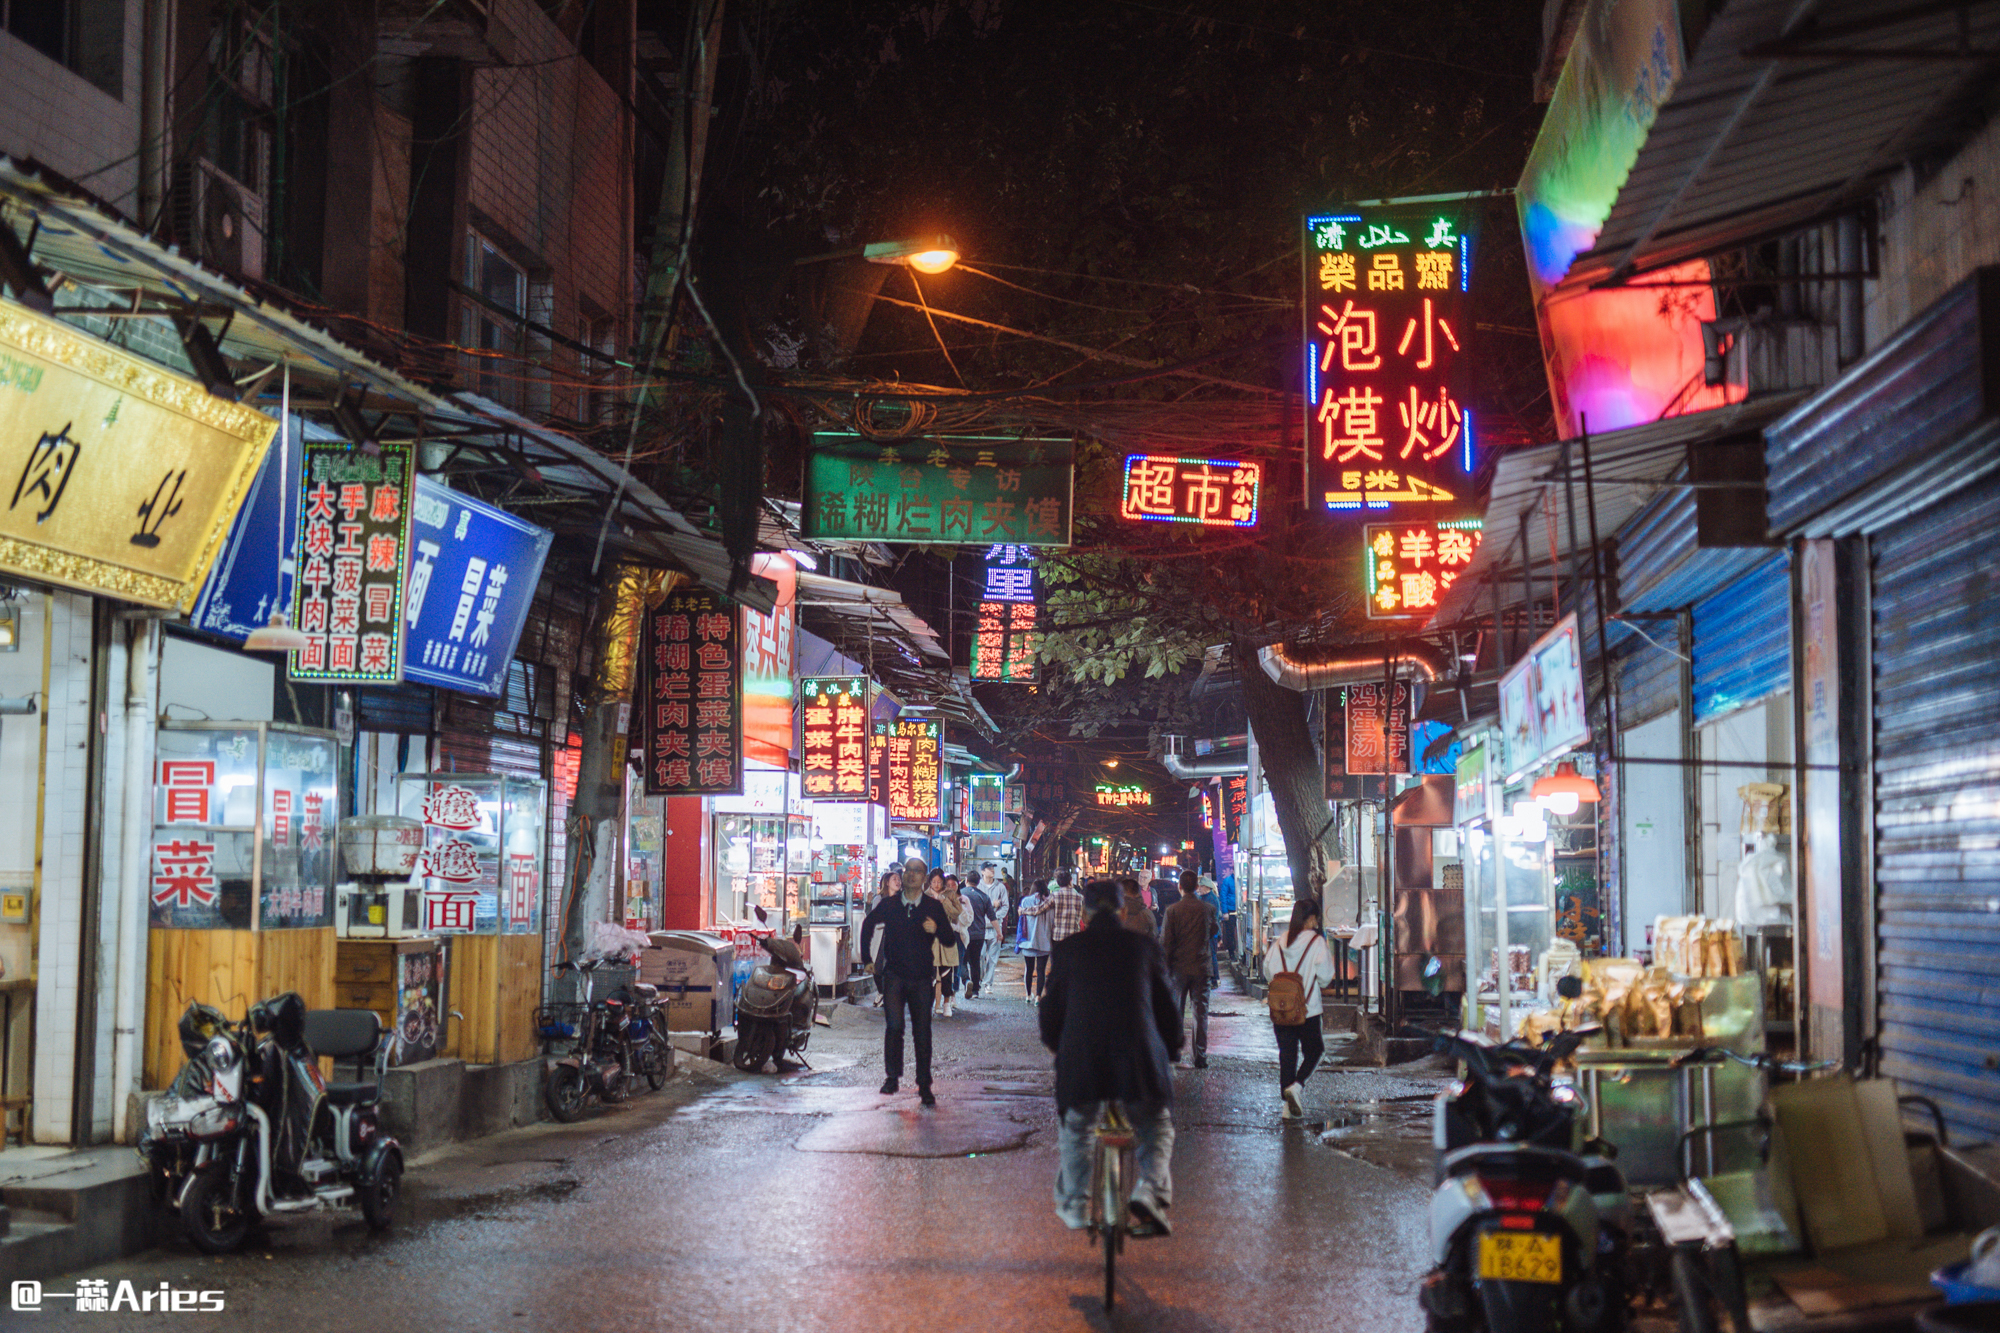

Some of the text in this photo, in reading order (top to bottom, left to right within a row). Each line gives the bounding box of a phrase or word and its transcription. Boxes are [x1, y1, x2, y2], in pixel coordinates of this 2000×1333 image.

[1317, 300, 1384, 462] 泡馍
[1398, 298, 1462, 461] 小炒
[850, 464, 1022, 492] 陕台专访
[878, 447, 998, 468] 李老三
[1128, 460, 1230, 519] 超市
[1342, 469, 1399, 490] 5米
[811, 491, 1062, 537] 稀糊烂肉夹馍
[300, 482, 336, 671] 大块牛肉面
[329, 483, 367, 672] 手工菠菜面
[360, 484, 400, 672] 麻辣冒菜
[671, 597, 713, 612] 李老三
[655, 614, 691, 787] 稀糊烂肉夹馍
[696, 613, 732, 787] 特色蛋菜夹馍
[1351, 683, 1377, 757] 鸡蛋汤
[805, 707, 833, 793] 蛋菜夹馍
[835, 706, 865, 793] 腊牛肉夹馍
[913, 737, 938, 807] 肉丸糊辣汤
[154, 759, 216, 906] 冒菜
[273, 789, 324, 850] 冒菜
